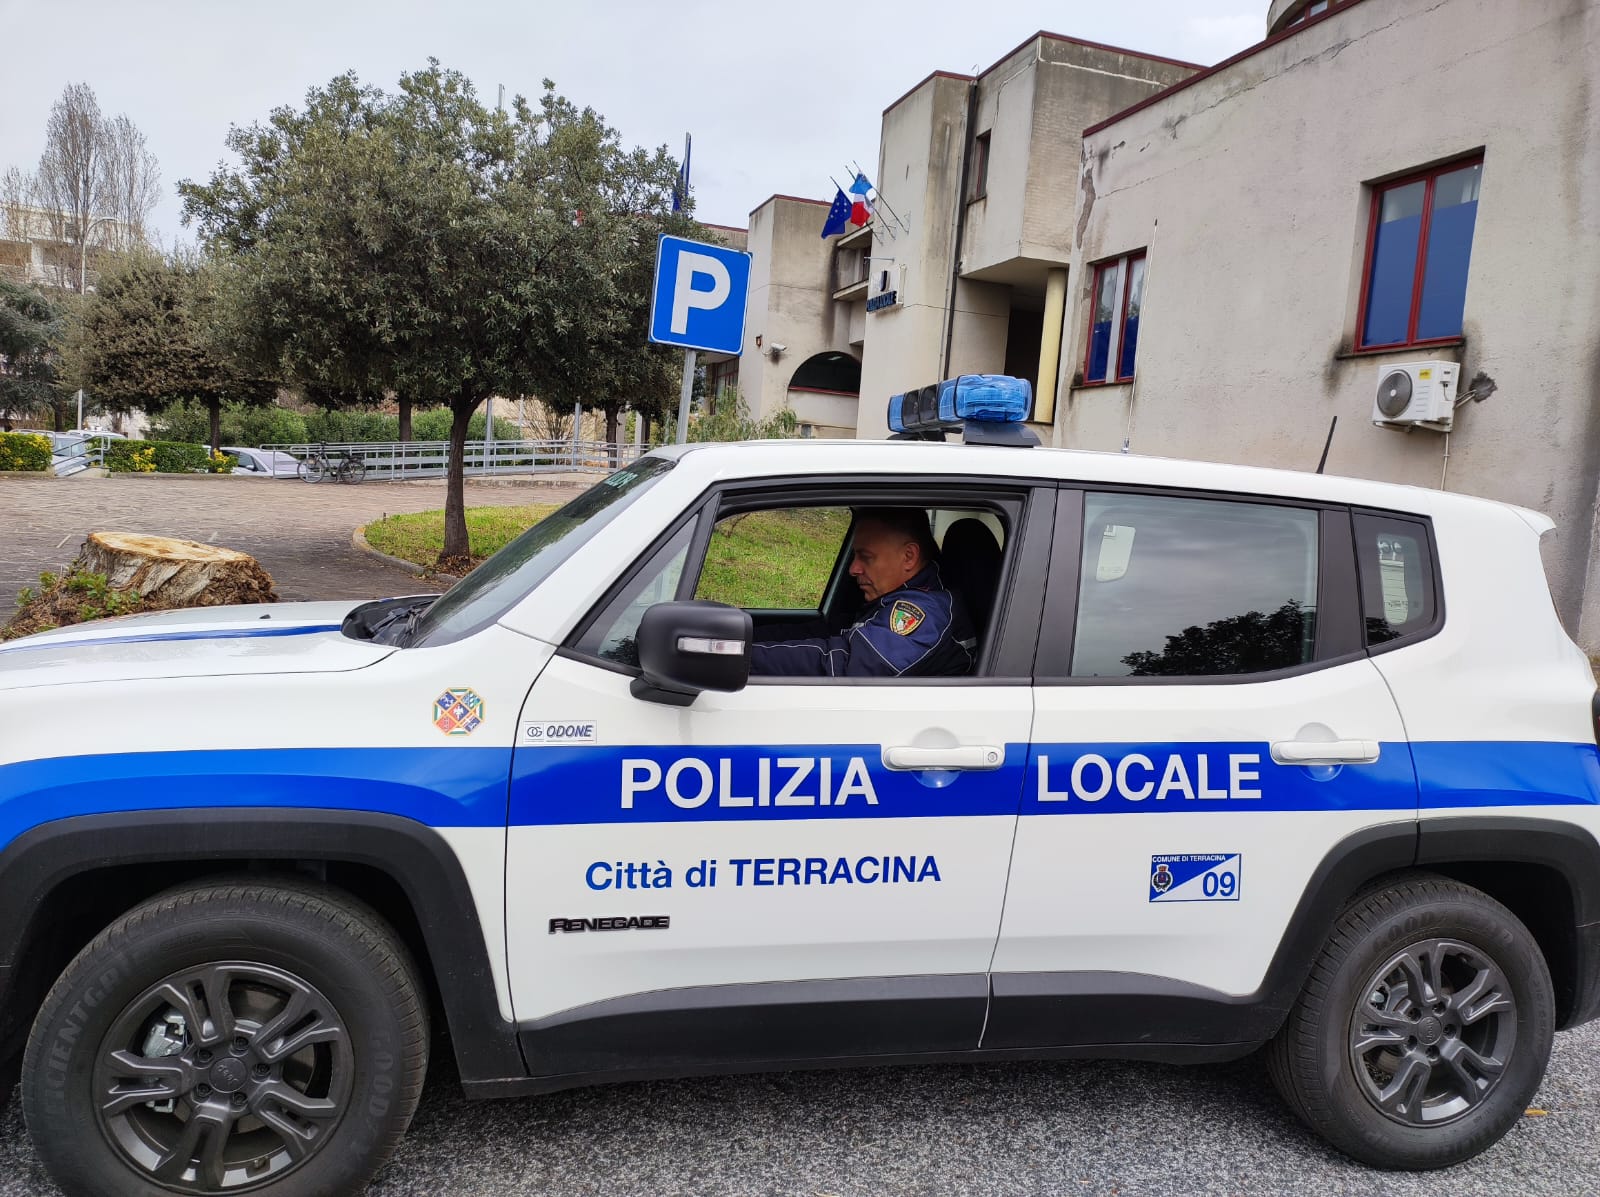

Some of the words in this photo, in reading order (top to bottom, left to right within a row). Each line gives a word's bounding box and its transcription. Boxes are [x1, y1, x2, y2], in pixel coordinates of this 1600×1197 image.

[670, 249, 731, 335] P
[546, 724, 594, 739] ODONE
[620, 756, 880, 809] POLIZIA
[1037, 753, 1262, 802] LOCALE
[1152, 855, 1181, 863] COMUNE
[1190, 854, 1226, 862] TERRACINA
[584, 859, 673, 891] Città
[685, 859, 718, 888] di
[728, 855, 942, 887] TERRACINA
[1202, 871, 1236, 897] 09
[548, 915, 671, 935] RENEGADE
